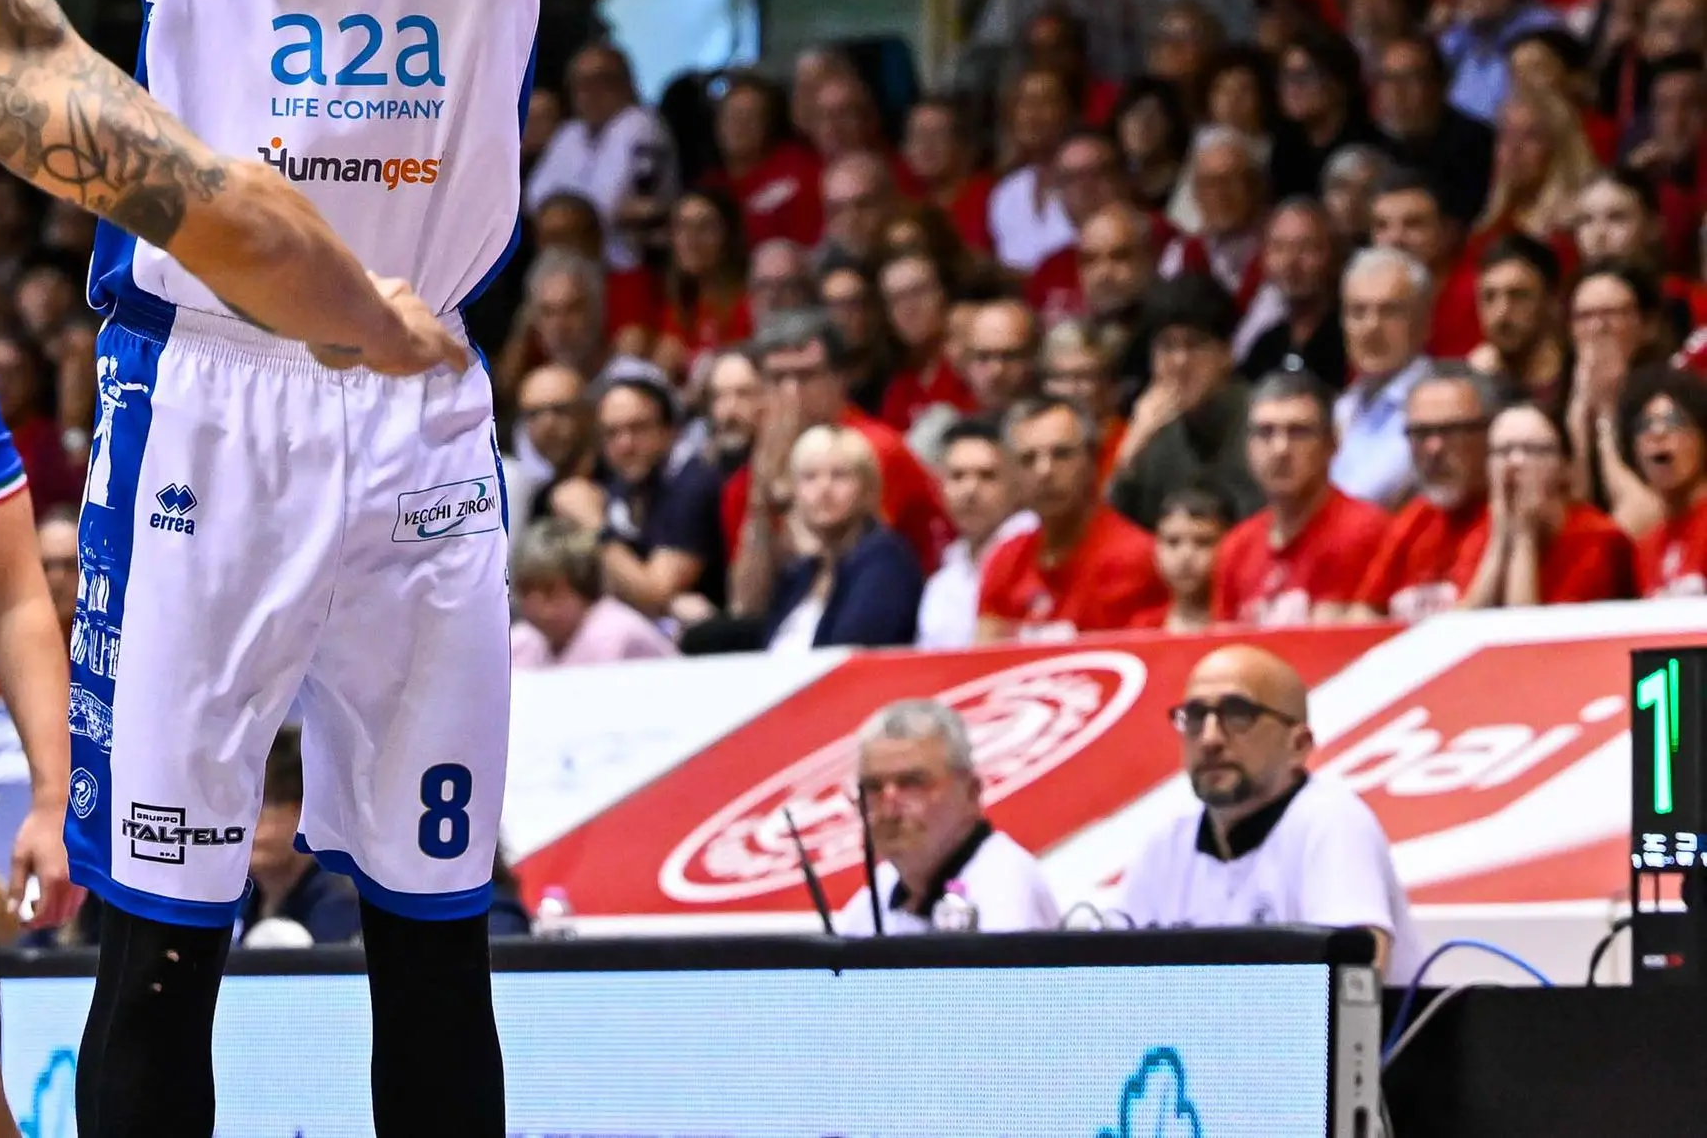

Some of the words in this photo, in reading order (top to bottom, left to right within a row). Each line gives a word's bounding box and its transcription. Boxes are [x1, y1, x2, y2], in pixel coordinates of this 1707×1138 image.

[270, 13, 446, 88] a2a
[271, 98, 319, 118] LIFE
[327, 99, 445, 120] COMPANY
[257, 137, 444, 191] Humanges
[150, 512, 195, 536] errea
[404, 504, 451, 526] VECCHI
[136, 812, 179, 824] GRUPPO
[417, 762, 473, 860] 8
